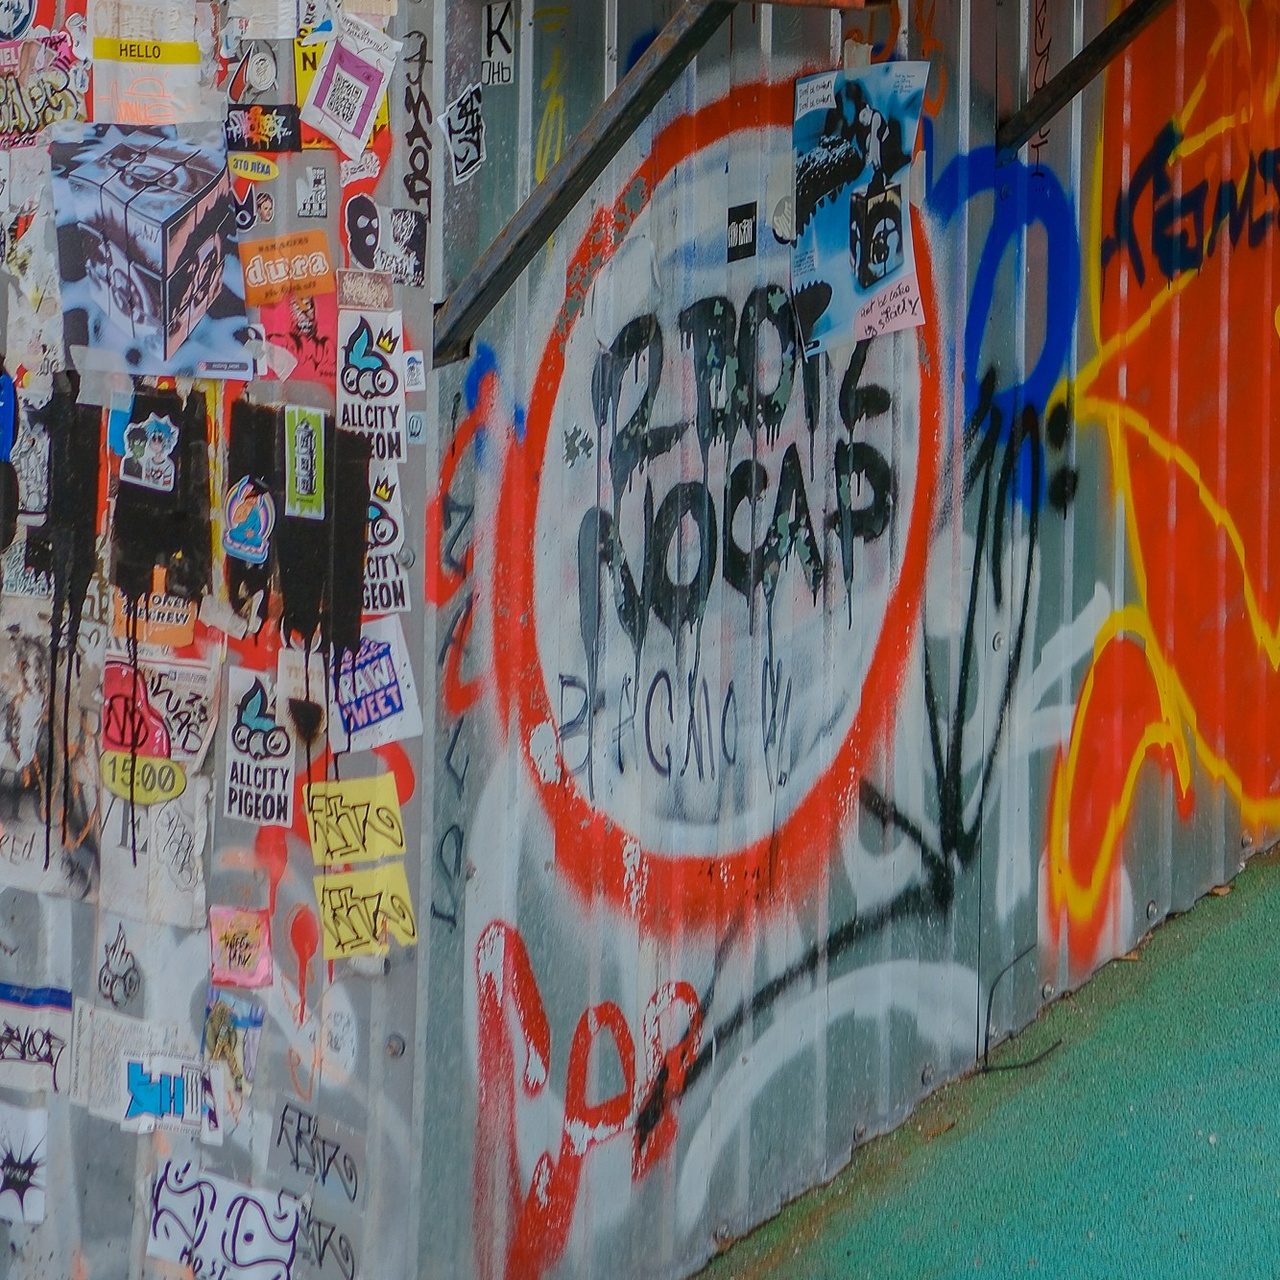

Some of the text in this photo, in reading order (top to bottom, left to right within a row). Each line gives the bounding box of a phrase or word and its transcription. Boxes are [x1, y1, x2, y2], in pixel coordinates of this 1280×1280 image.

[119, 43, 161, 59] HELLO
[232, 157, 271, 176] ЭТО ЛЁХА
[246, 251, 330, 287] dura
[341, 403, 400, 428] ALLCITY
[363, 552, 402, 579] CITY
[361, 582, 406, 611] GEON
[340, 662, 392, 704] RAW
[107, 755, 176, 793] 15:00
[229, 760, 290, 792] ALLCITY
[228, 787, 289, 823] PIGEON
